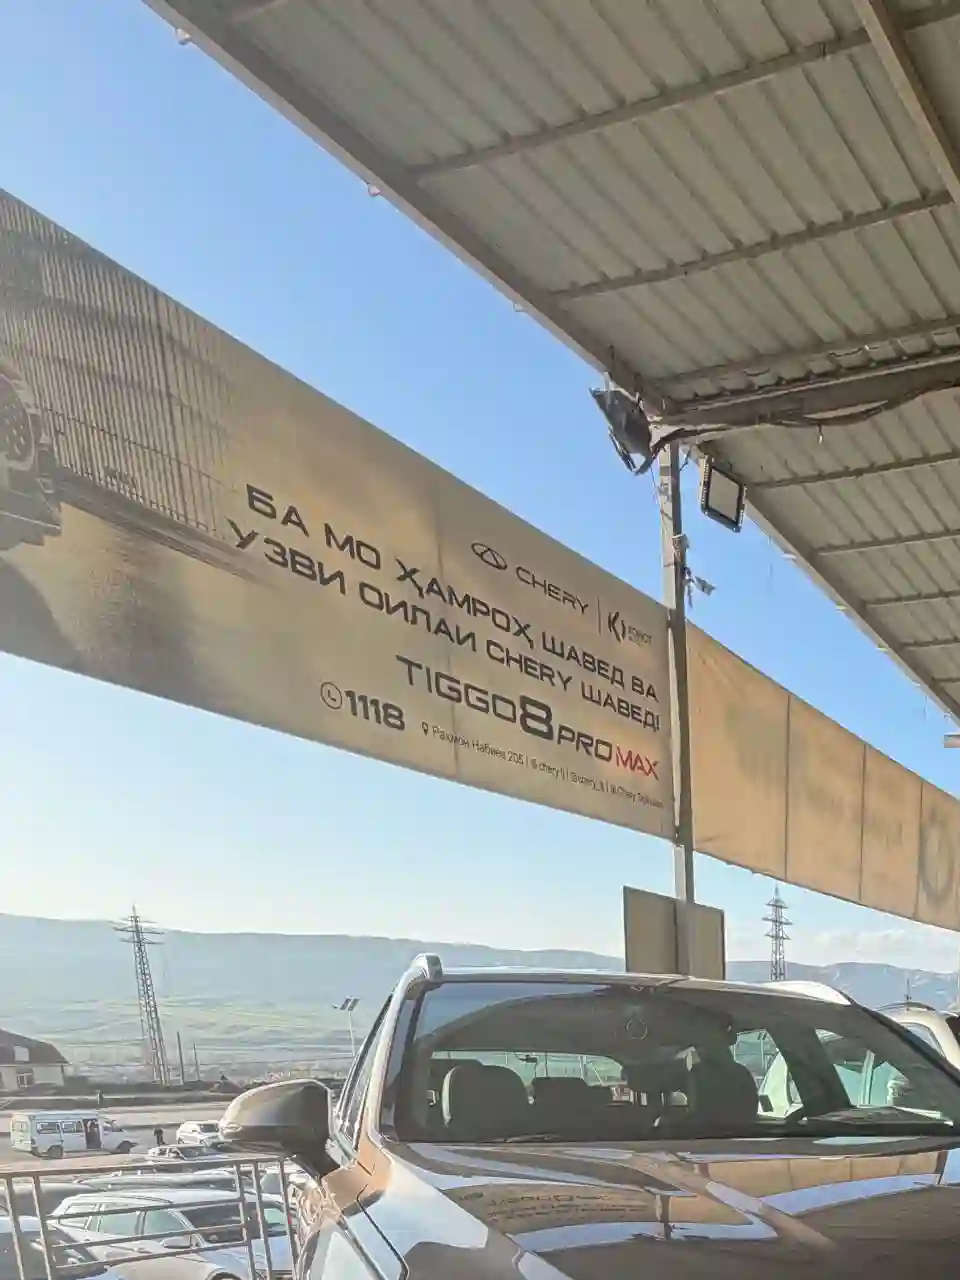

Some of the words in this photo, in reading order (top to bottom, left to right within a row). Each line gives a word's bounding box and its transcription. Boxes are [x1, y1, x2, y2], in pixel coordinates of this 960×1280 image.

[246, 483, 310, 538] БА
[324, 522, 381, 570] МО
[541, 631, 625, 690] ШАВЕД
[632, 675, 660, 703] ВА
[516, 566, 589, 615] CHERY
[224, 516, 346, 595] УЗВИ
[359, 581, 477, 652] ОИЛАИ
[486, 639, 573, 692] CHERY
[581, 680, 660, 733] ШАВЕД!
[344, 689, 406, 731] 1118
[557, 724, 613, 762] PRO
[616, 744, 661, 780] MAX
